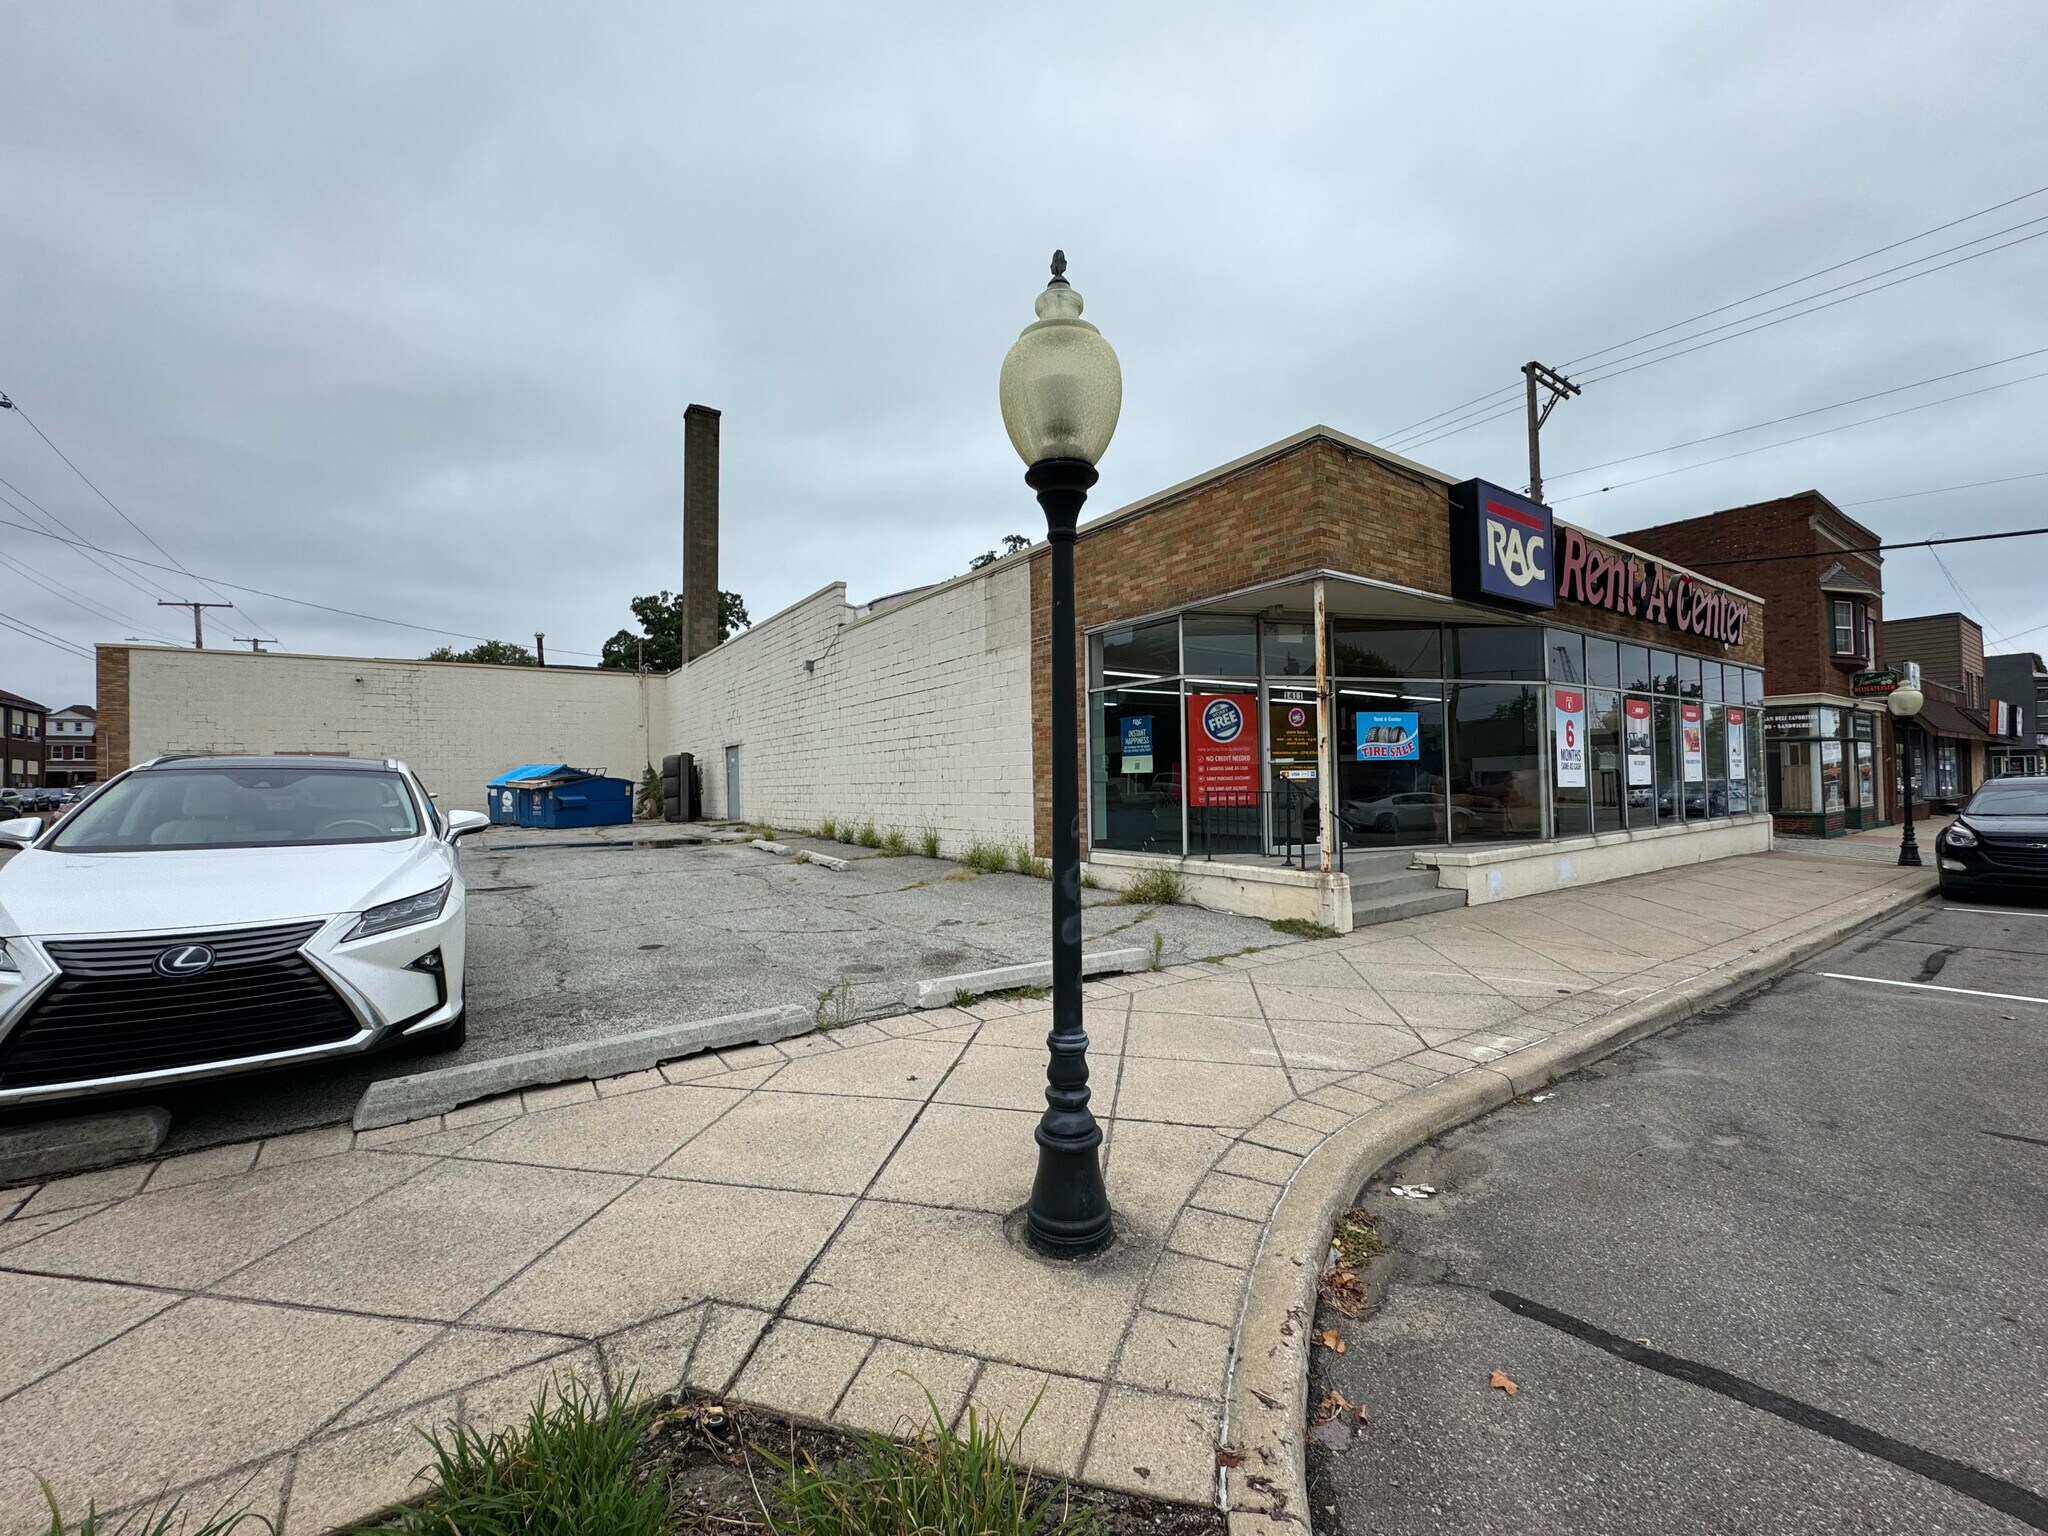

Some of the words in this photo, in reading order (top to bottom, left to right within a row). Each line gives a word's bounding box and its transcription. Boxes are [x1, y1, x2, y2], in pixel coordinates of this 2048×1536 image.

[1486, 519, 1546, 587] RAC
[1284, 691, 1304, 700] 1411
[1854, 685, 1895, 693] DELICATESSEN
[1208, 710, 1238, 732] FREE
[1128, 729, 1146, 737] INSTANT
[1565, 719, 1575, 748] 6
[1125, 736, 1149, 745] HAPPINESS
[1361, 746, 1387, 758] TIRE
[1389, 740, 1416, 757] SALE
[1560, 748, 1582, 761] MONTHS
